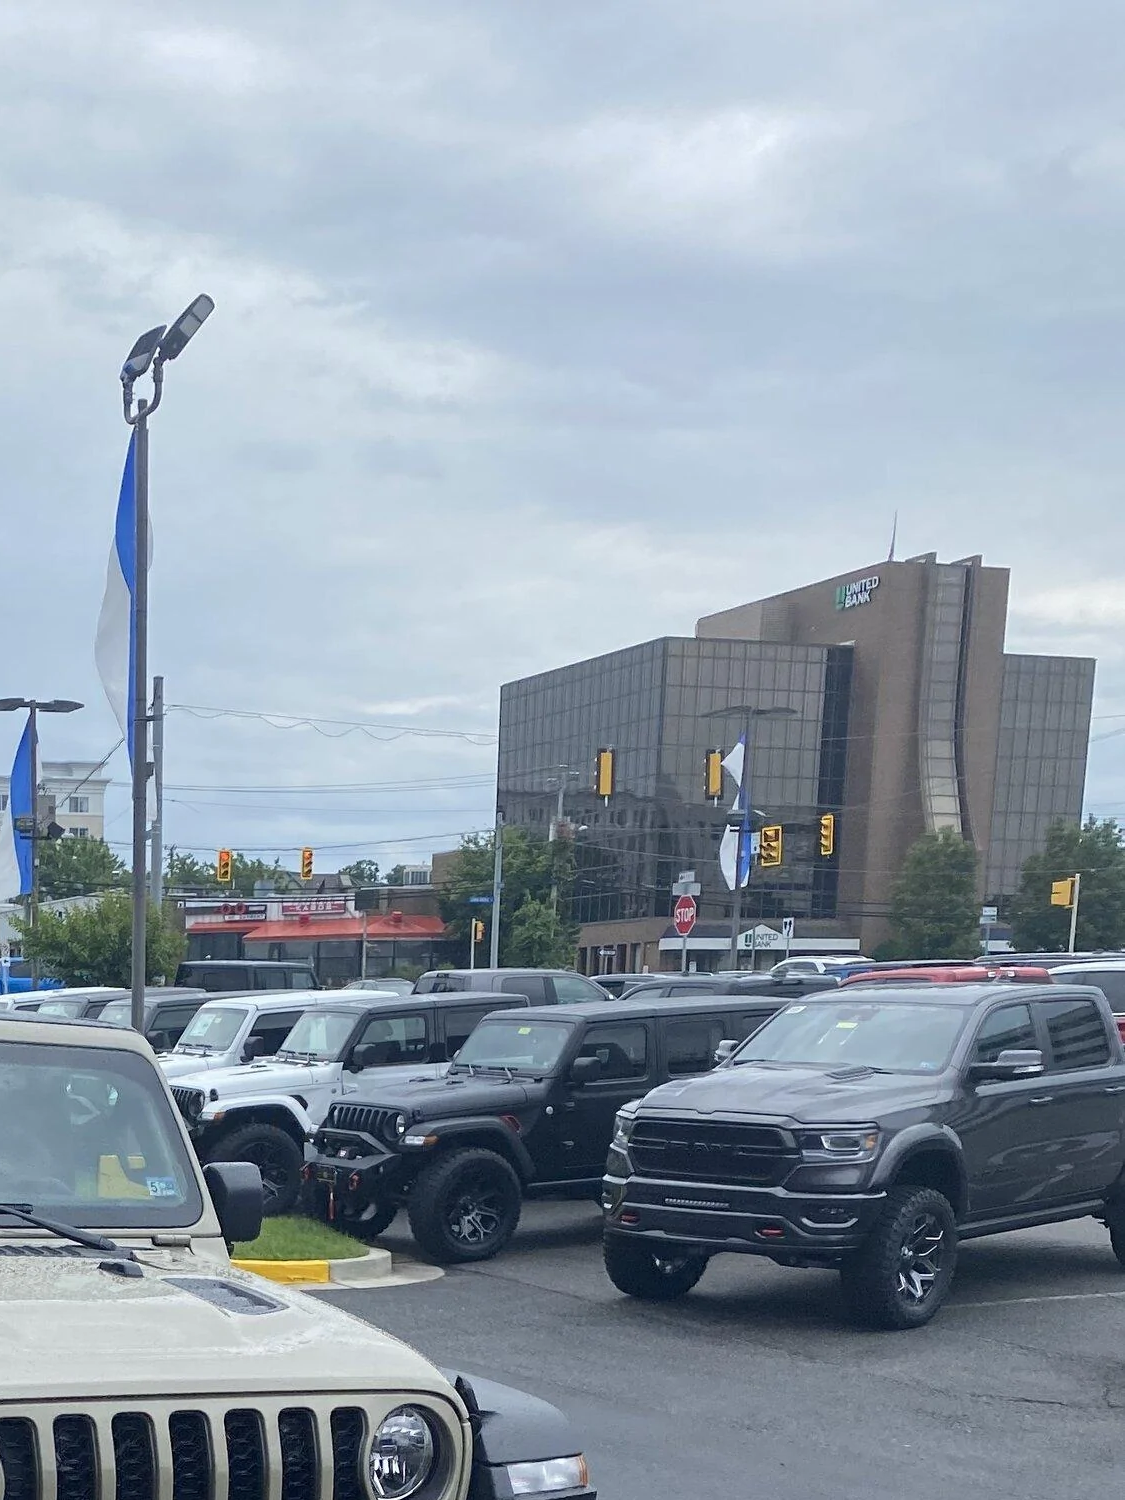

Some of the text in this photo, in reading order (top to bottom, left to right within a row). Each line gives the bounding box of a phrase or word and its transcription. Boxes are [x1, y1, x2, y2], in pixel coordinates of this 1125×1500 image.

[846, 576, 879, 596] UNITED
[845, 589, 871, 608] BANK
[675, 907, 694, 923] STOP
